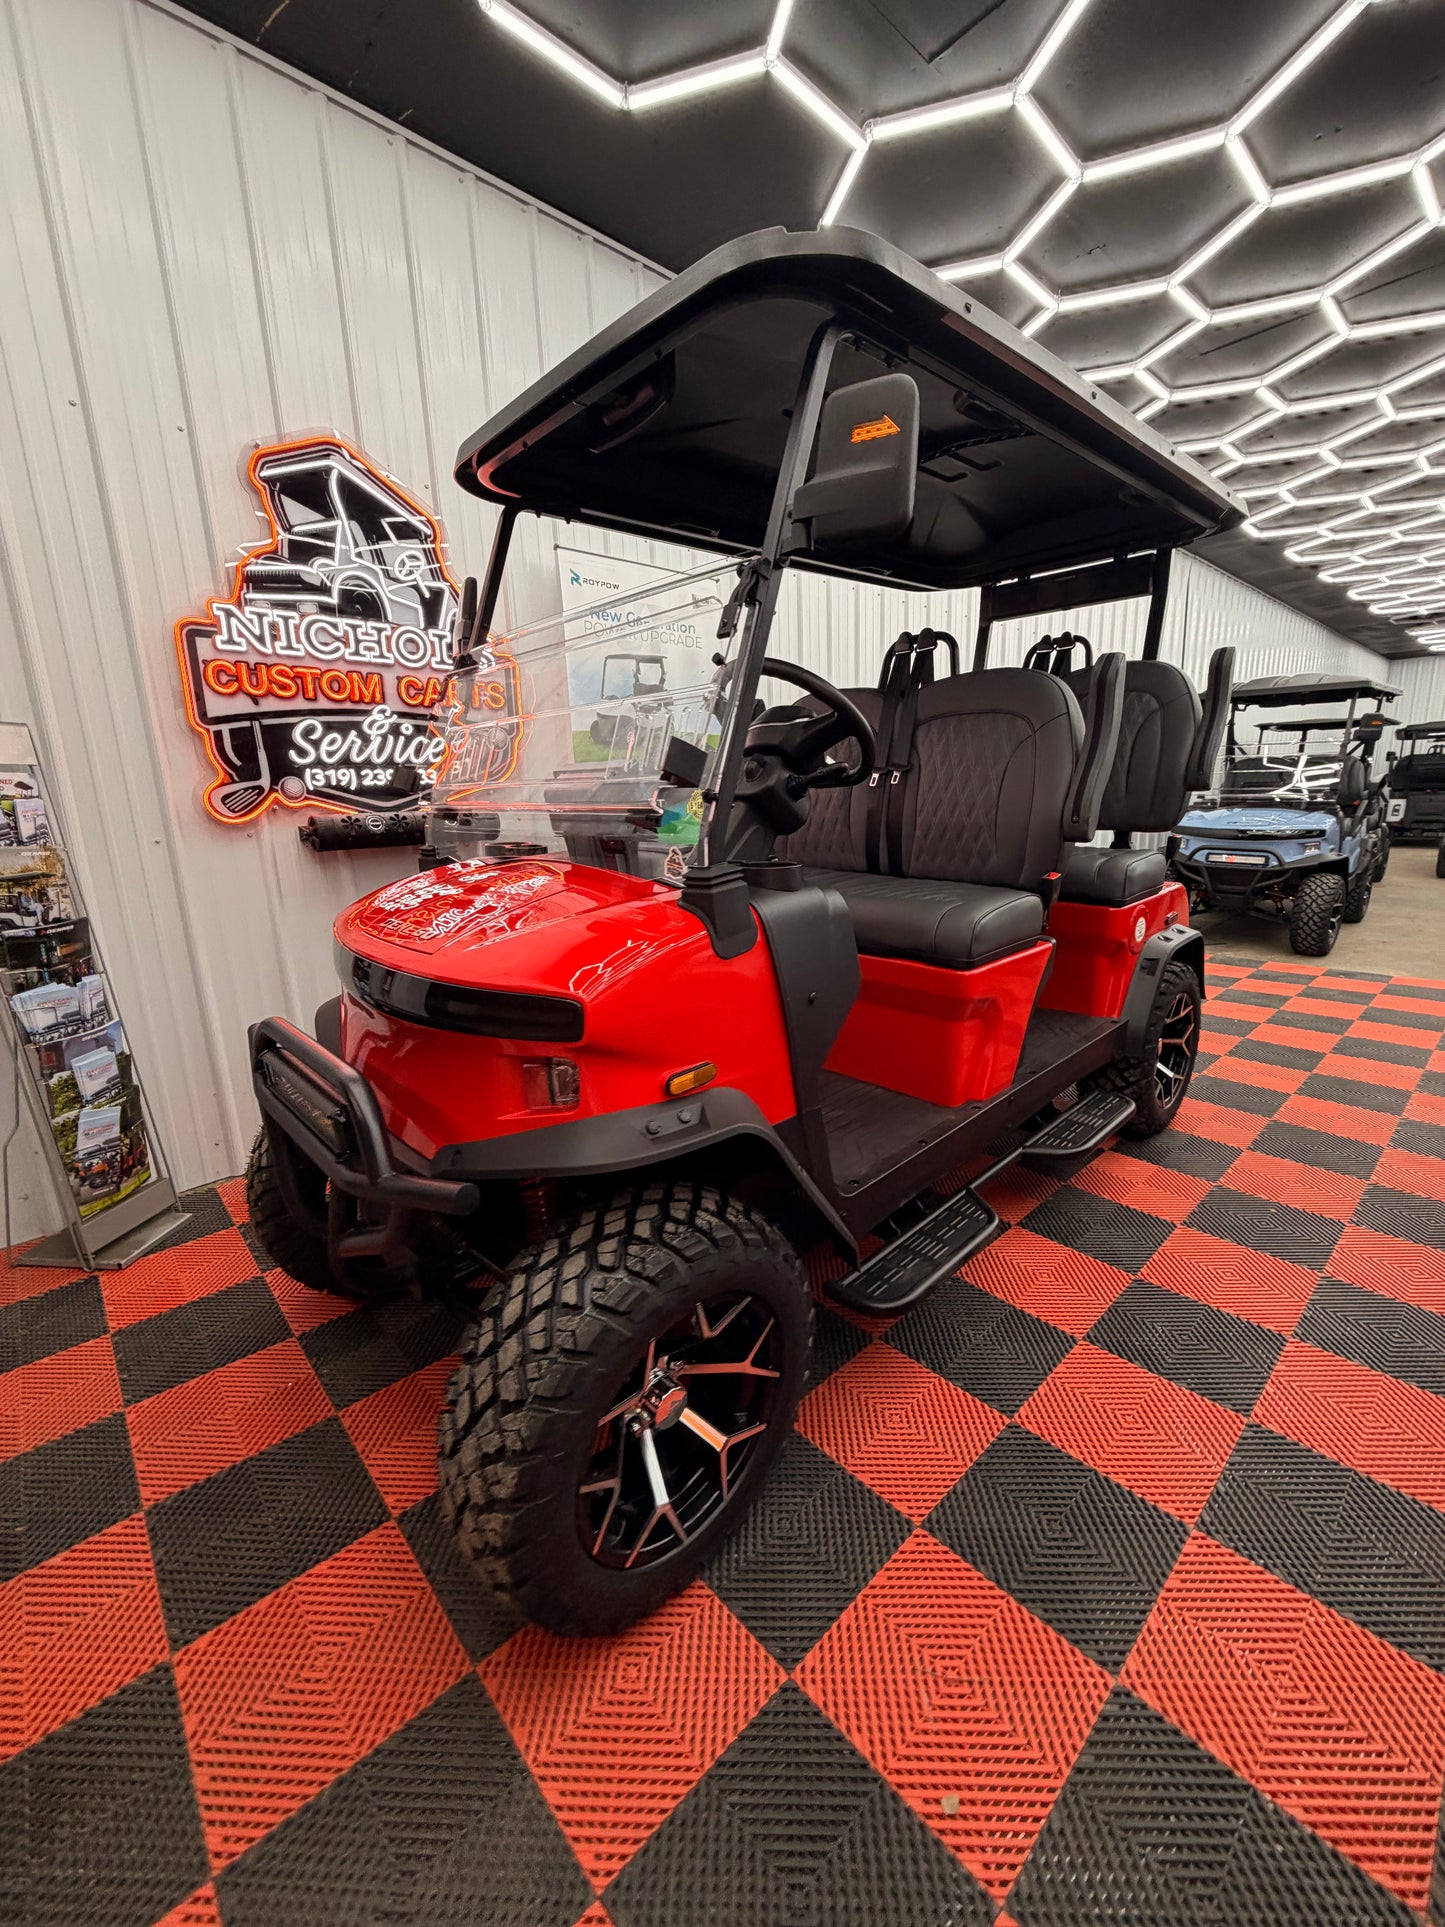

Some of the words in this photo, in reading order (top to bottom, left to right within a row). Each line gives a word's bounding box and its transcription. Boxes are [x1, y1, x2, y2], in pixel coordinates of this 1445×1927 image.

[582, 577, 621, 590] ROYPOW
[640, 630, 704, 650] UPGRADE
[203, 657, 386, 705] CUSTOM
[362, 704, 398, 736] &
[288, 718, 447, 765] Service
[304, 767, 358, 791] (319)
